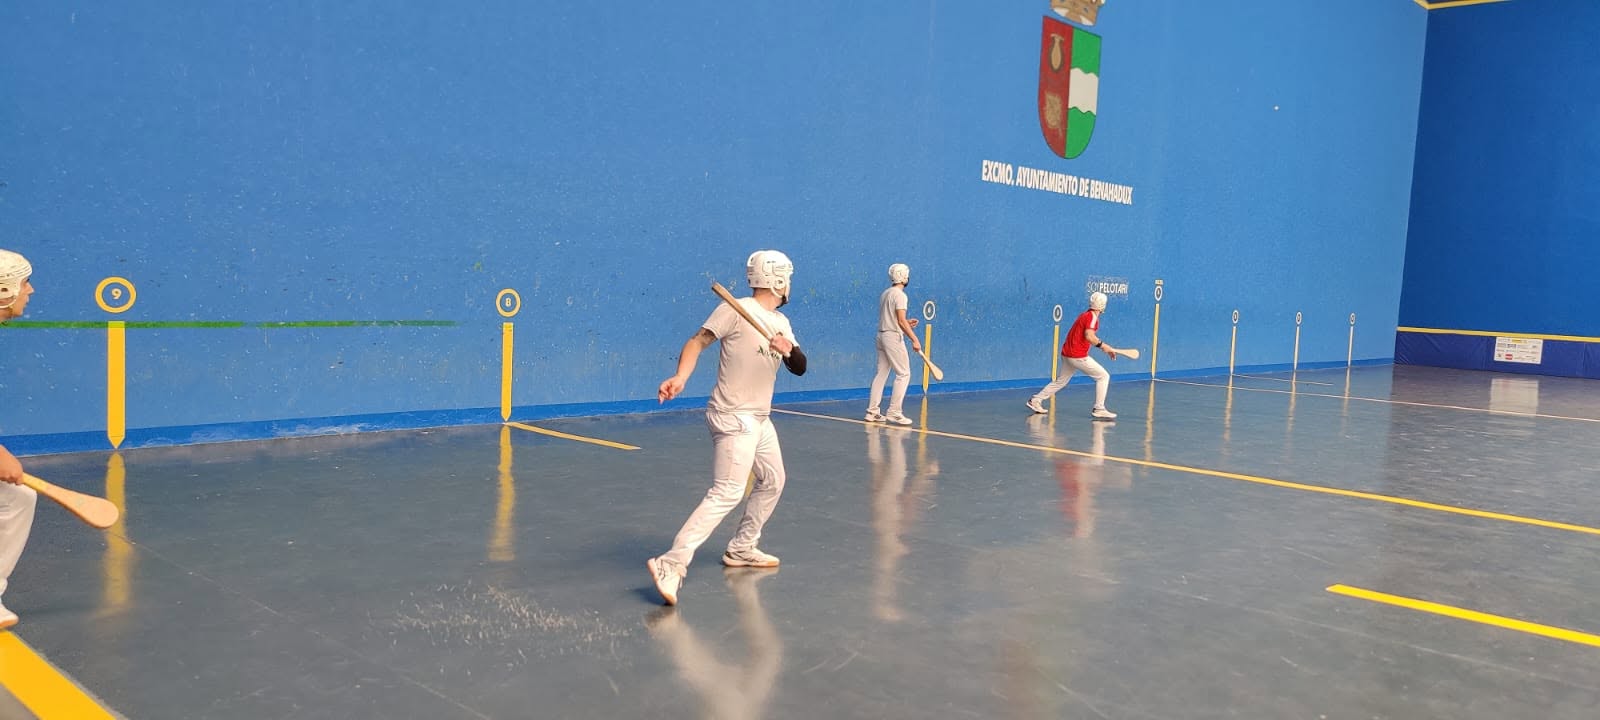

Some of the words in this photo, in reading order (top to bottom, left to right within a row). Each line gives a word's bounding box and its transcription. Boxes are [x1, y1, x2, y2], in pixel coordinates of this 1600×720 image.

[981, 159, 1014, 186] EXCMO.
[1015, 166, 1078, 195] AYUNTAMIENTO
[1078, 177, 1089, 198] DE
[1089, 179, 1133, 205] BENAHADUX
[111, 288, 122, 300] 9
[505, 297, 512, 307] 8
